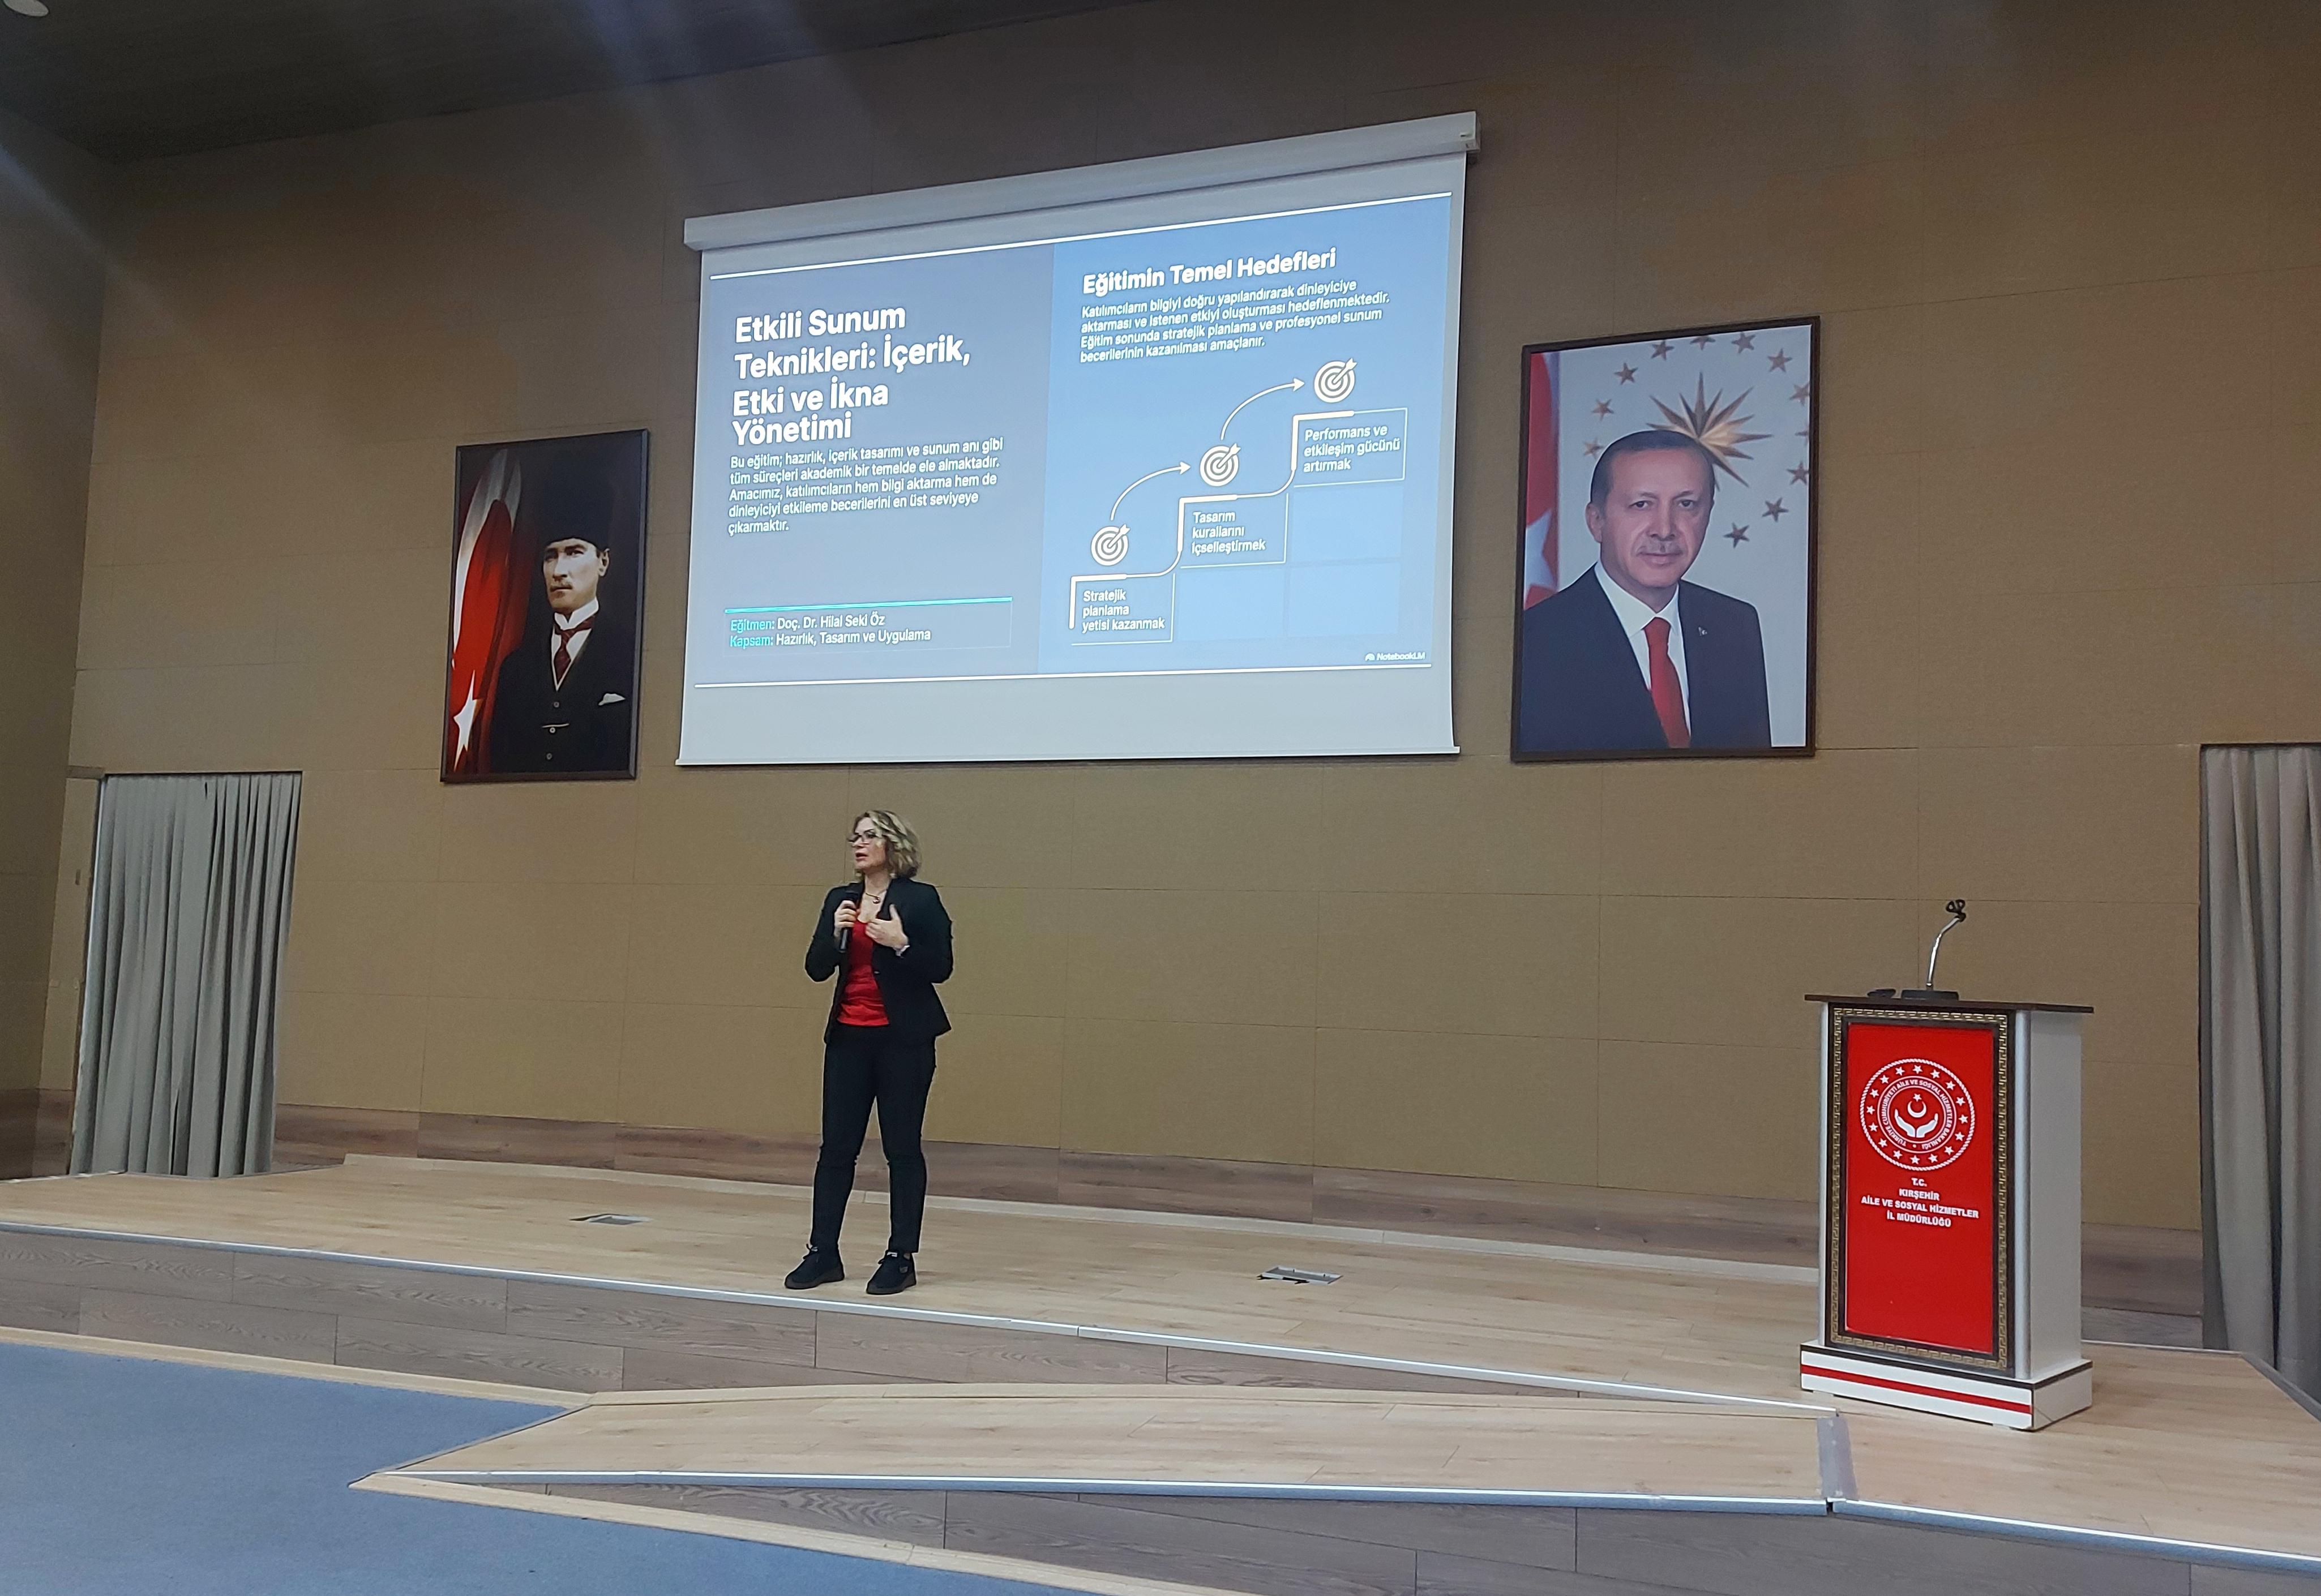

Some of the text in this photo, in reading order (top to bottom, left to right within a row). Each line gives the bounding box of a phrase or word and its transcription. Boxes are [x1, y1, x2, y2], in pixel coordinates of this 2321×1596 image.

[1083, 247, 1336, 297] Eğitimin Temel Hedefleri
[1082, 280, 1356, 318] Katılımcıların bilgiyi doğru yapılandırarak dinleyiciye
[1081, 291, 1390, 333] aktarması ve istenen etkiyi oluşturması hedeflenmektedir.
[735, 307, 905, 342] Etkili Sunum
[1081, 310, 1382, 350] Eğitim sonunda stratejik planlama ve profesyonel sunum
[735, 333, 970, 379] Teknikleri: İçerik,
[1080, 336, 1265, 363] becerilerinin kazanılması amaçlanır.
[733, 376, 889, 416] Etki ve İkna
[733, 410, 851, 445] Yönetimi
[1305, 426, 1388, 441] Performans ve
[730, 436, 1003, 469] Bu eğitim; hazırlık, içerik tasarımı ve sunum anı gibi
[1304, 438, 1401, 457] etkileşim gücünü
[730, 456, 1000, 484] tüm süreçleri akademik bir temelde ele almaktadır.
[1304, 458, 1351, 473] artırmak
[729, 472, 997, 501] Amacımız, katılımcıların hem bilgi aktarma hem de
[729, 492, 978, 518] dinleyiciyi etkileme becerilerini en üst seviyeye
[728, 520, 789, 537] çıkarmaktır.
[1193, 512, 1235, 524] Tasarım
[1192, 525, 1244, 538] kurallarını
[1192, 539, 1266, 556] içselleştirmek
[1083, 589, 1126, 603] Stratejik
[730, 611, 885, 633] Eğitmen: Doç. Dr. Hilal Seki Öz
[1082, 604, 1129, 619] planlama
[1082, 617, 1165, 633] yetisi kazanmak
[730, 629, 931, 649] Kapsam: Hazırlık, Tasarım ve Uygulama
[1911, 1177, 1927, 1187] T.C.
[1899, 1189, 1939, 1201] KIRŞEHİR
[1861, 1195, 1979, 1219] AİLE VE SOSYAL HİZMETLER
[1887, 1210, 1951, 1227] İL MÜDÜRLÜĞÜ
